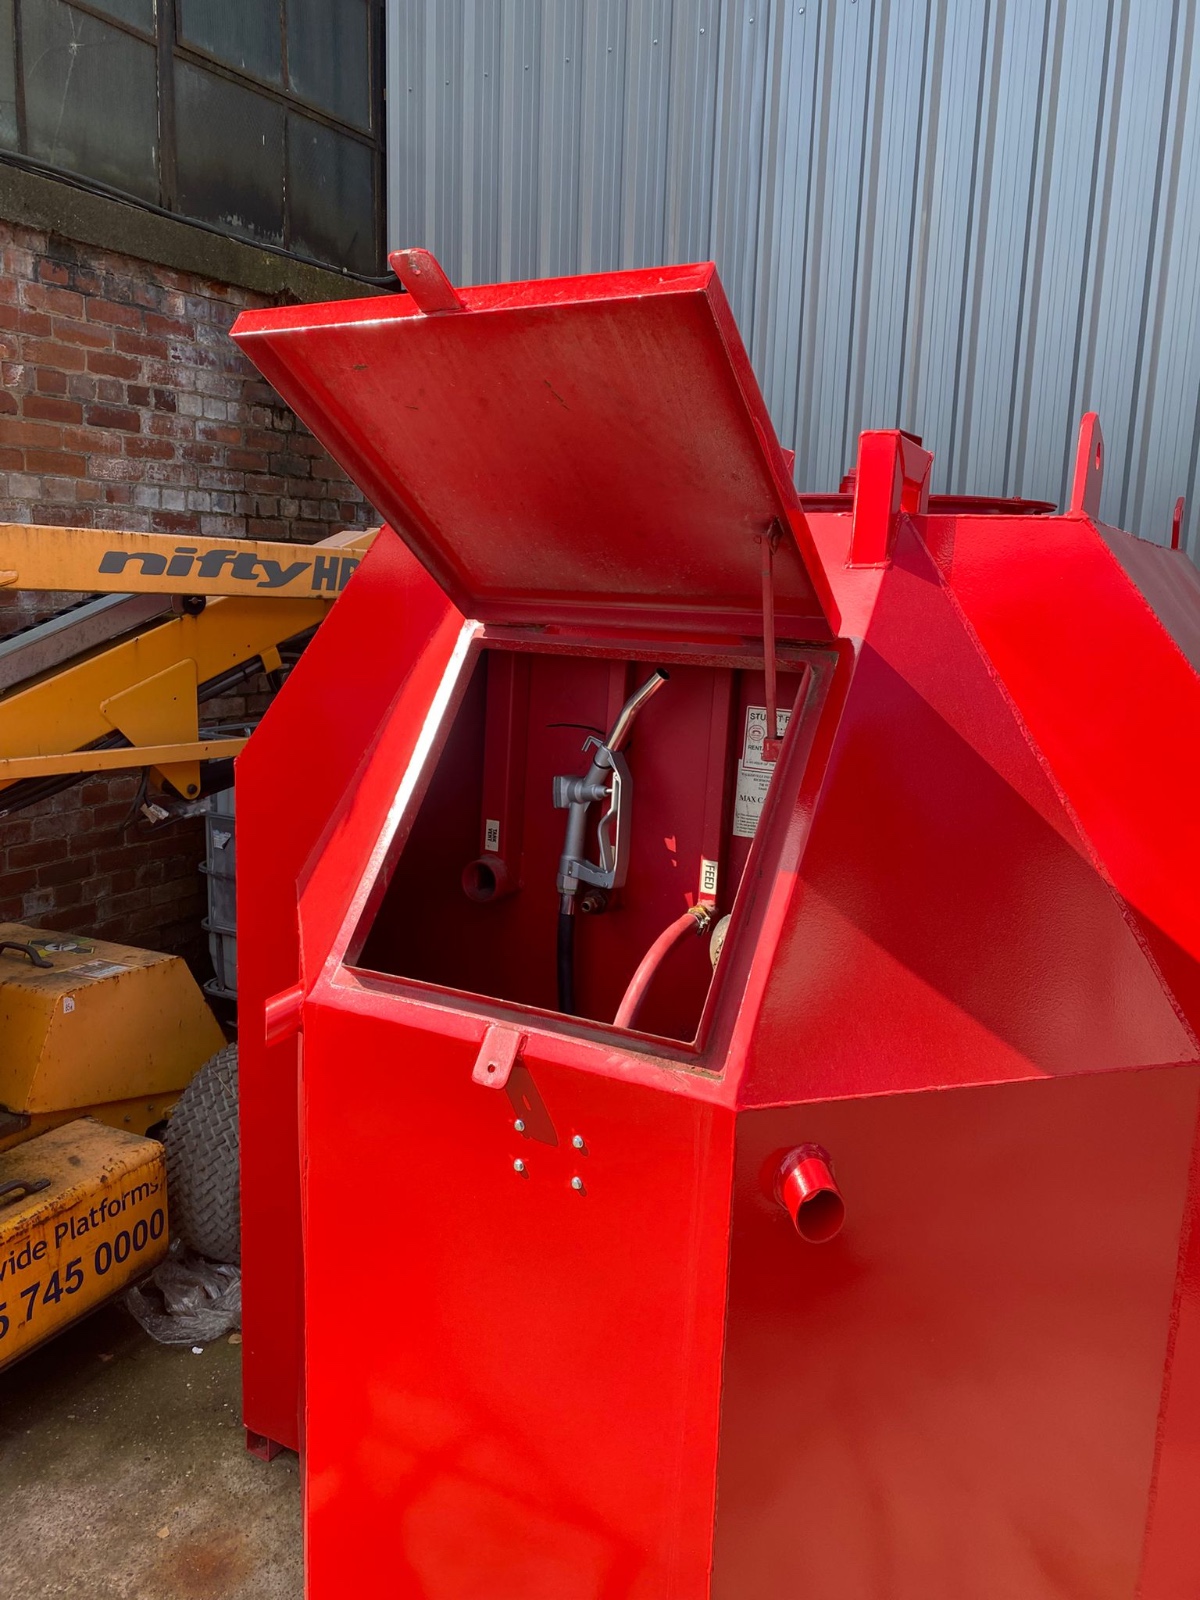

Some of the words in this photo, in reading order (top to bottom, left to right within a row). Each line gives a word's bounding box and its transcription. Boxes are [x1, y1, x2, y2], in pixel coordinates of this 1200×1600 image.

[750, 712, 784, 723] STUT
[739, 794, 756, 804] MAX
[704, 864, 716, 890] FEED
[54, 1182, 159, 1250] Platforms
[20, 1257, 85, 1322] 745
[94, 1208, 165, 1276] 0000
